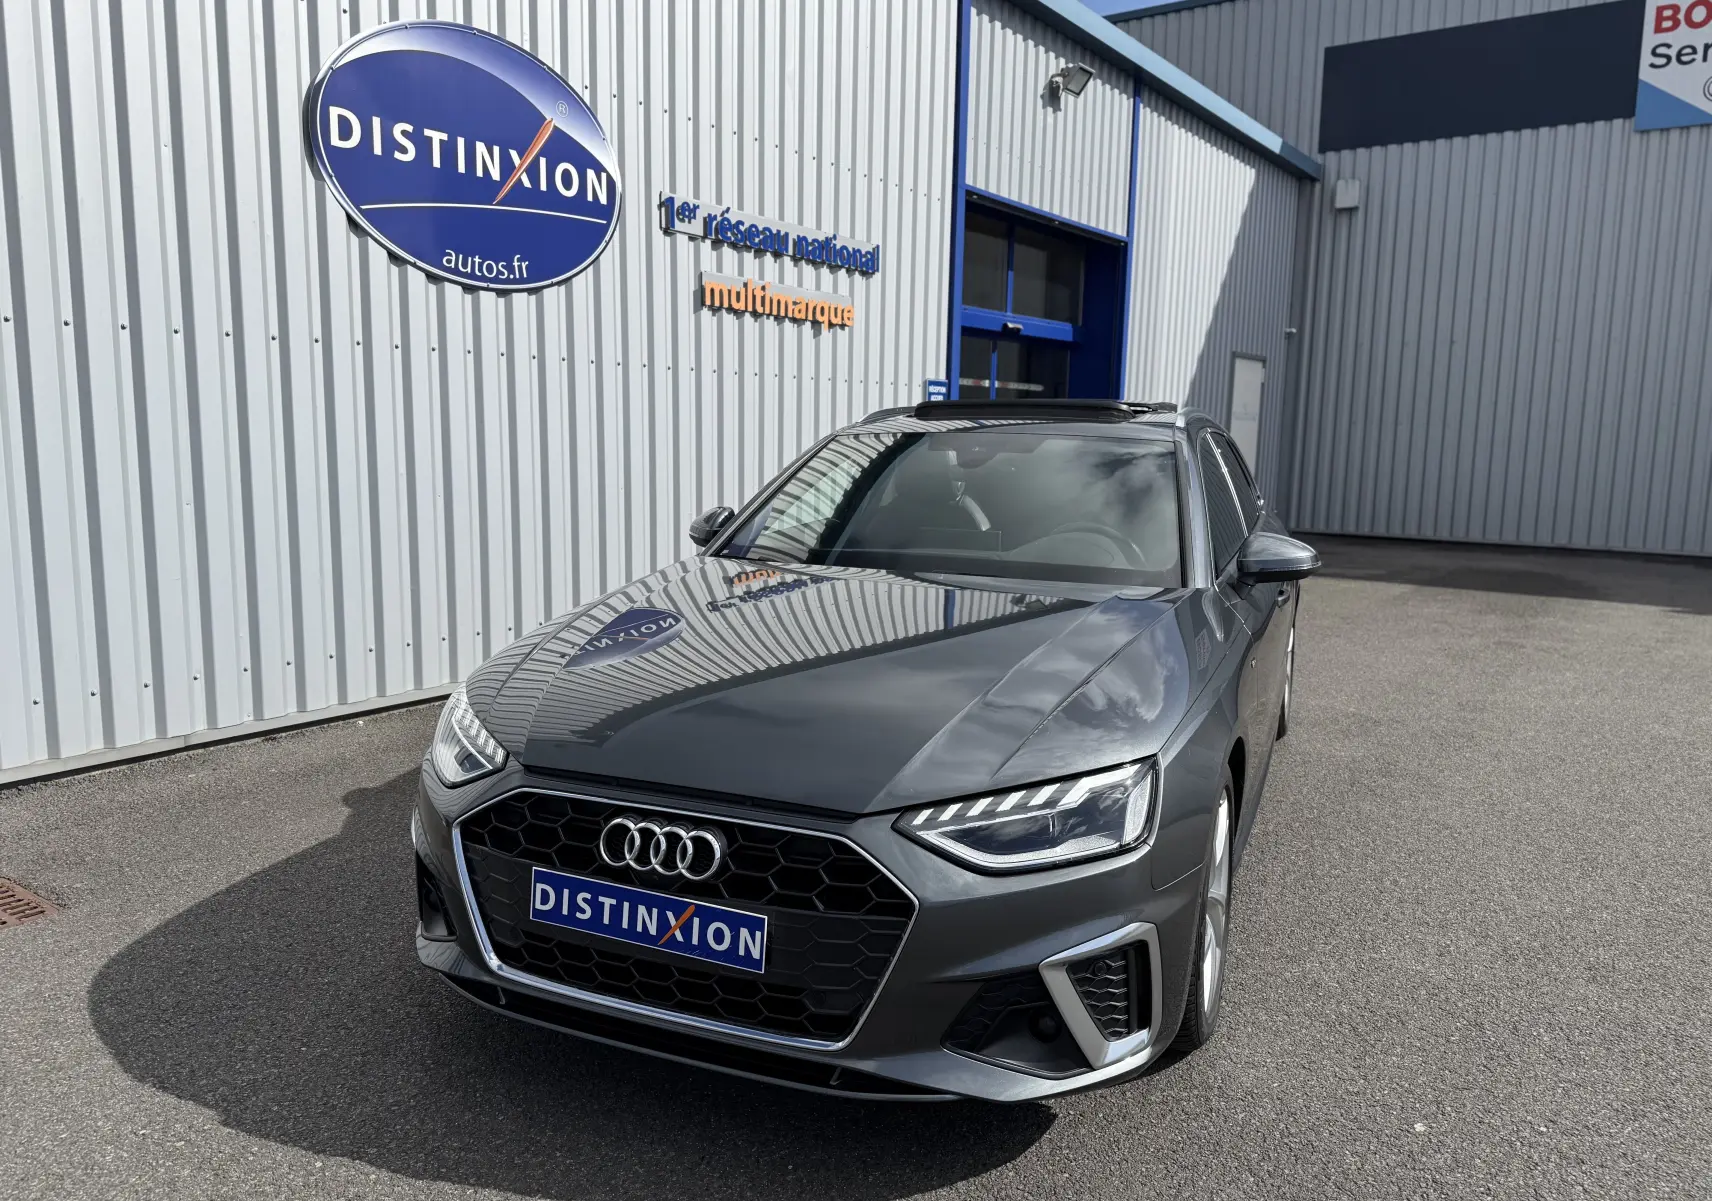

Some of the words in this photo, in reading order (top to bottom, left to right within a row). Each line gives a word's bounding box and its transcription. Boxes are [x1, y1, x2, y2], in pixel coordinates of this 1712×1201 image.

[1653, 0, 1712, 35] BO
[328, 105, 608, 206] DISTINXION
[442, 249, 529, 280] autos.fr
[664, 196, 700, 229] 1er
[706, 207, 790, 254] réseau
[796, 233, 880, 273] national
[703, 278, 855, 331] multimarque
[534, 882, 762, 960] DISTINXION
